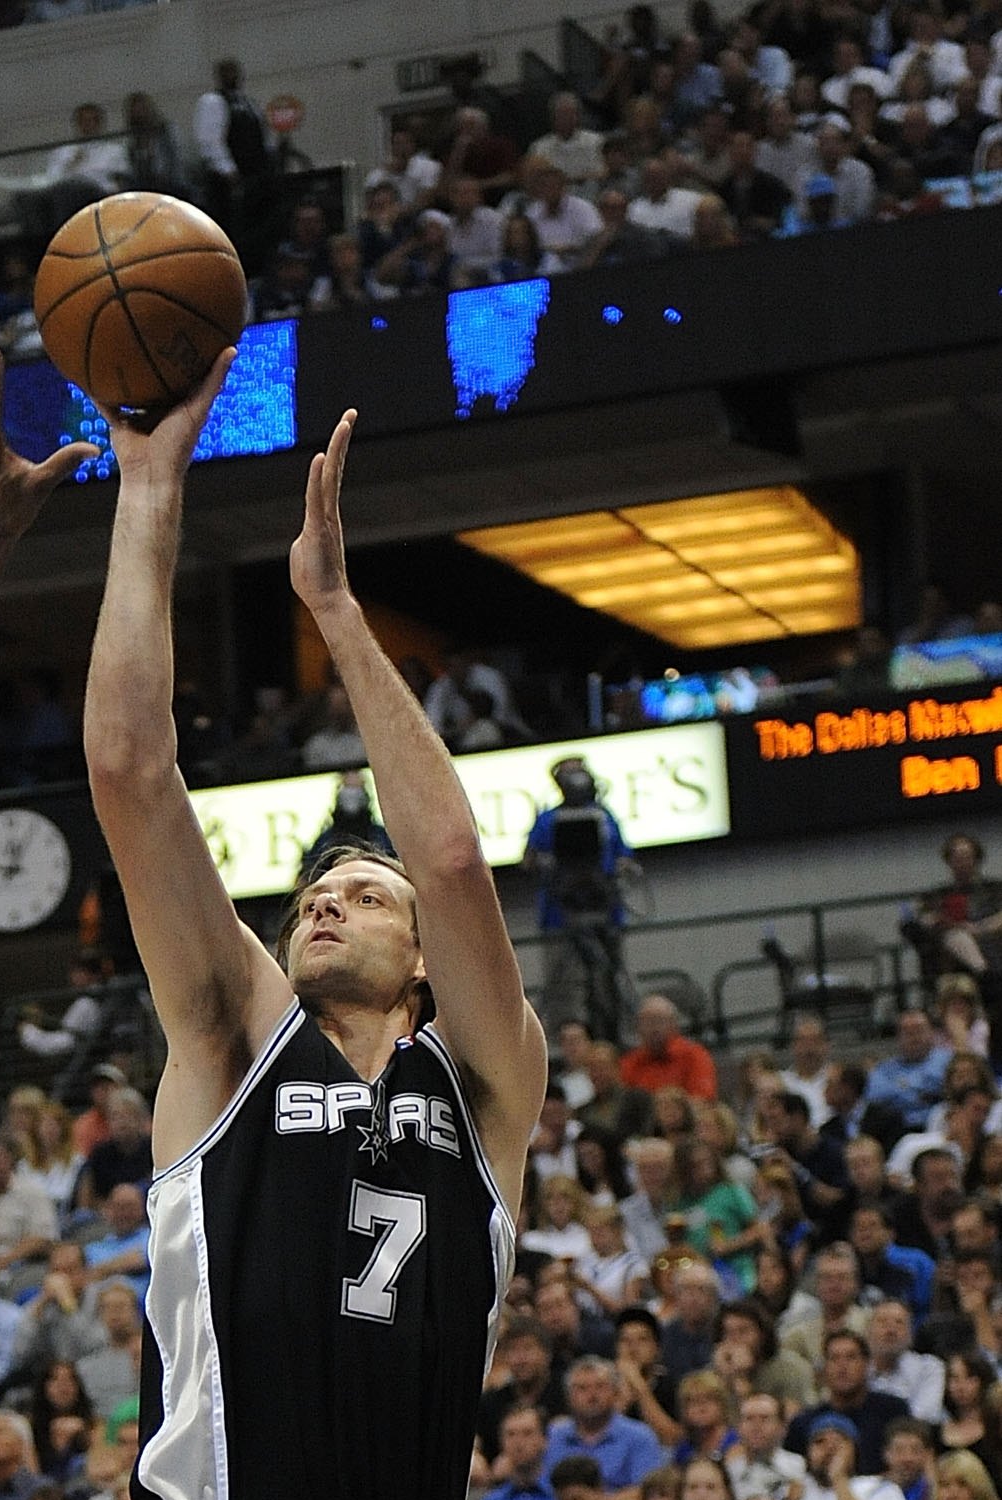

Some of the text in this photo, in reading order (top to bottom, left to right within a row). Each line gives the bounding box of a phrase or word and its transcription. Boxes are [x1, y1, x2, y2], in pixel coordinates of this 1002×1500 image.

[755, 719, 814, 761] The
[815, 708, 907, 754] Dallas
[901, 755, 980, 798] Ben
[340, 1178, 427, 1325] 7
